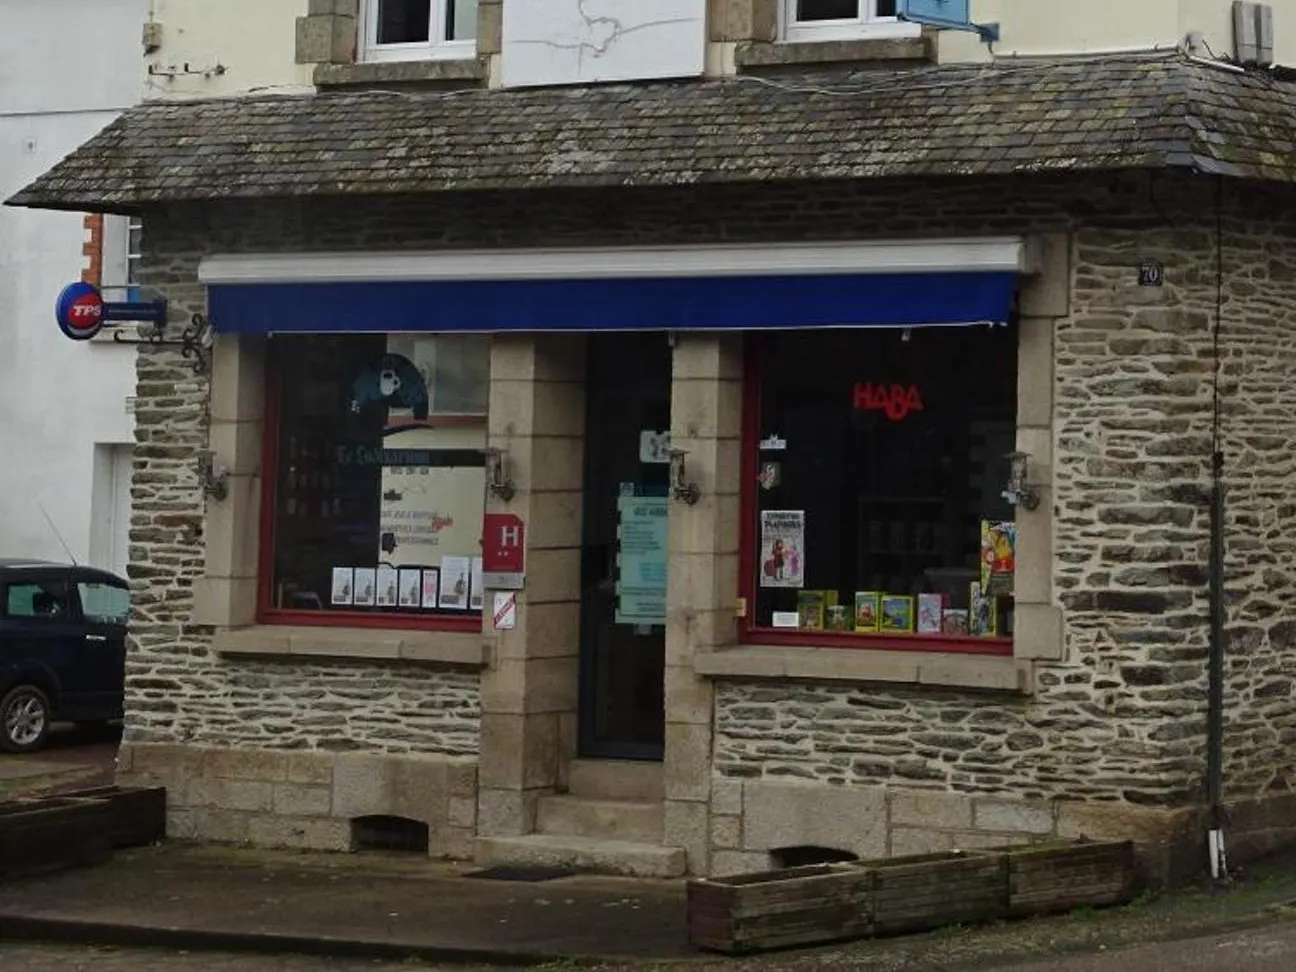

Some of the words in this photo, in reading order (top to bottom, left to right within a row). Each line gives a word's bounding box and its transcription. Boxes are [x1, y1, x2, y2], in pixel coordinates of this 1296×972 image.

[72, 303, 101, 317] TPS
[852, 381, 925, 420] HABA
[500, 525, 520, 548] H
